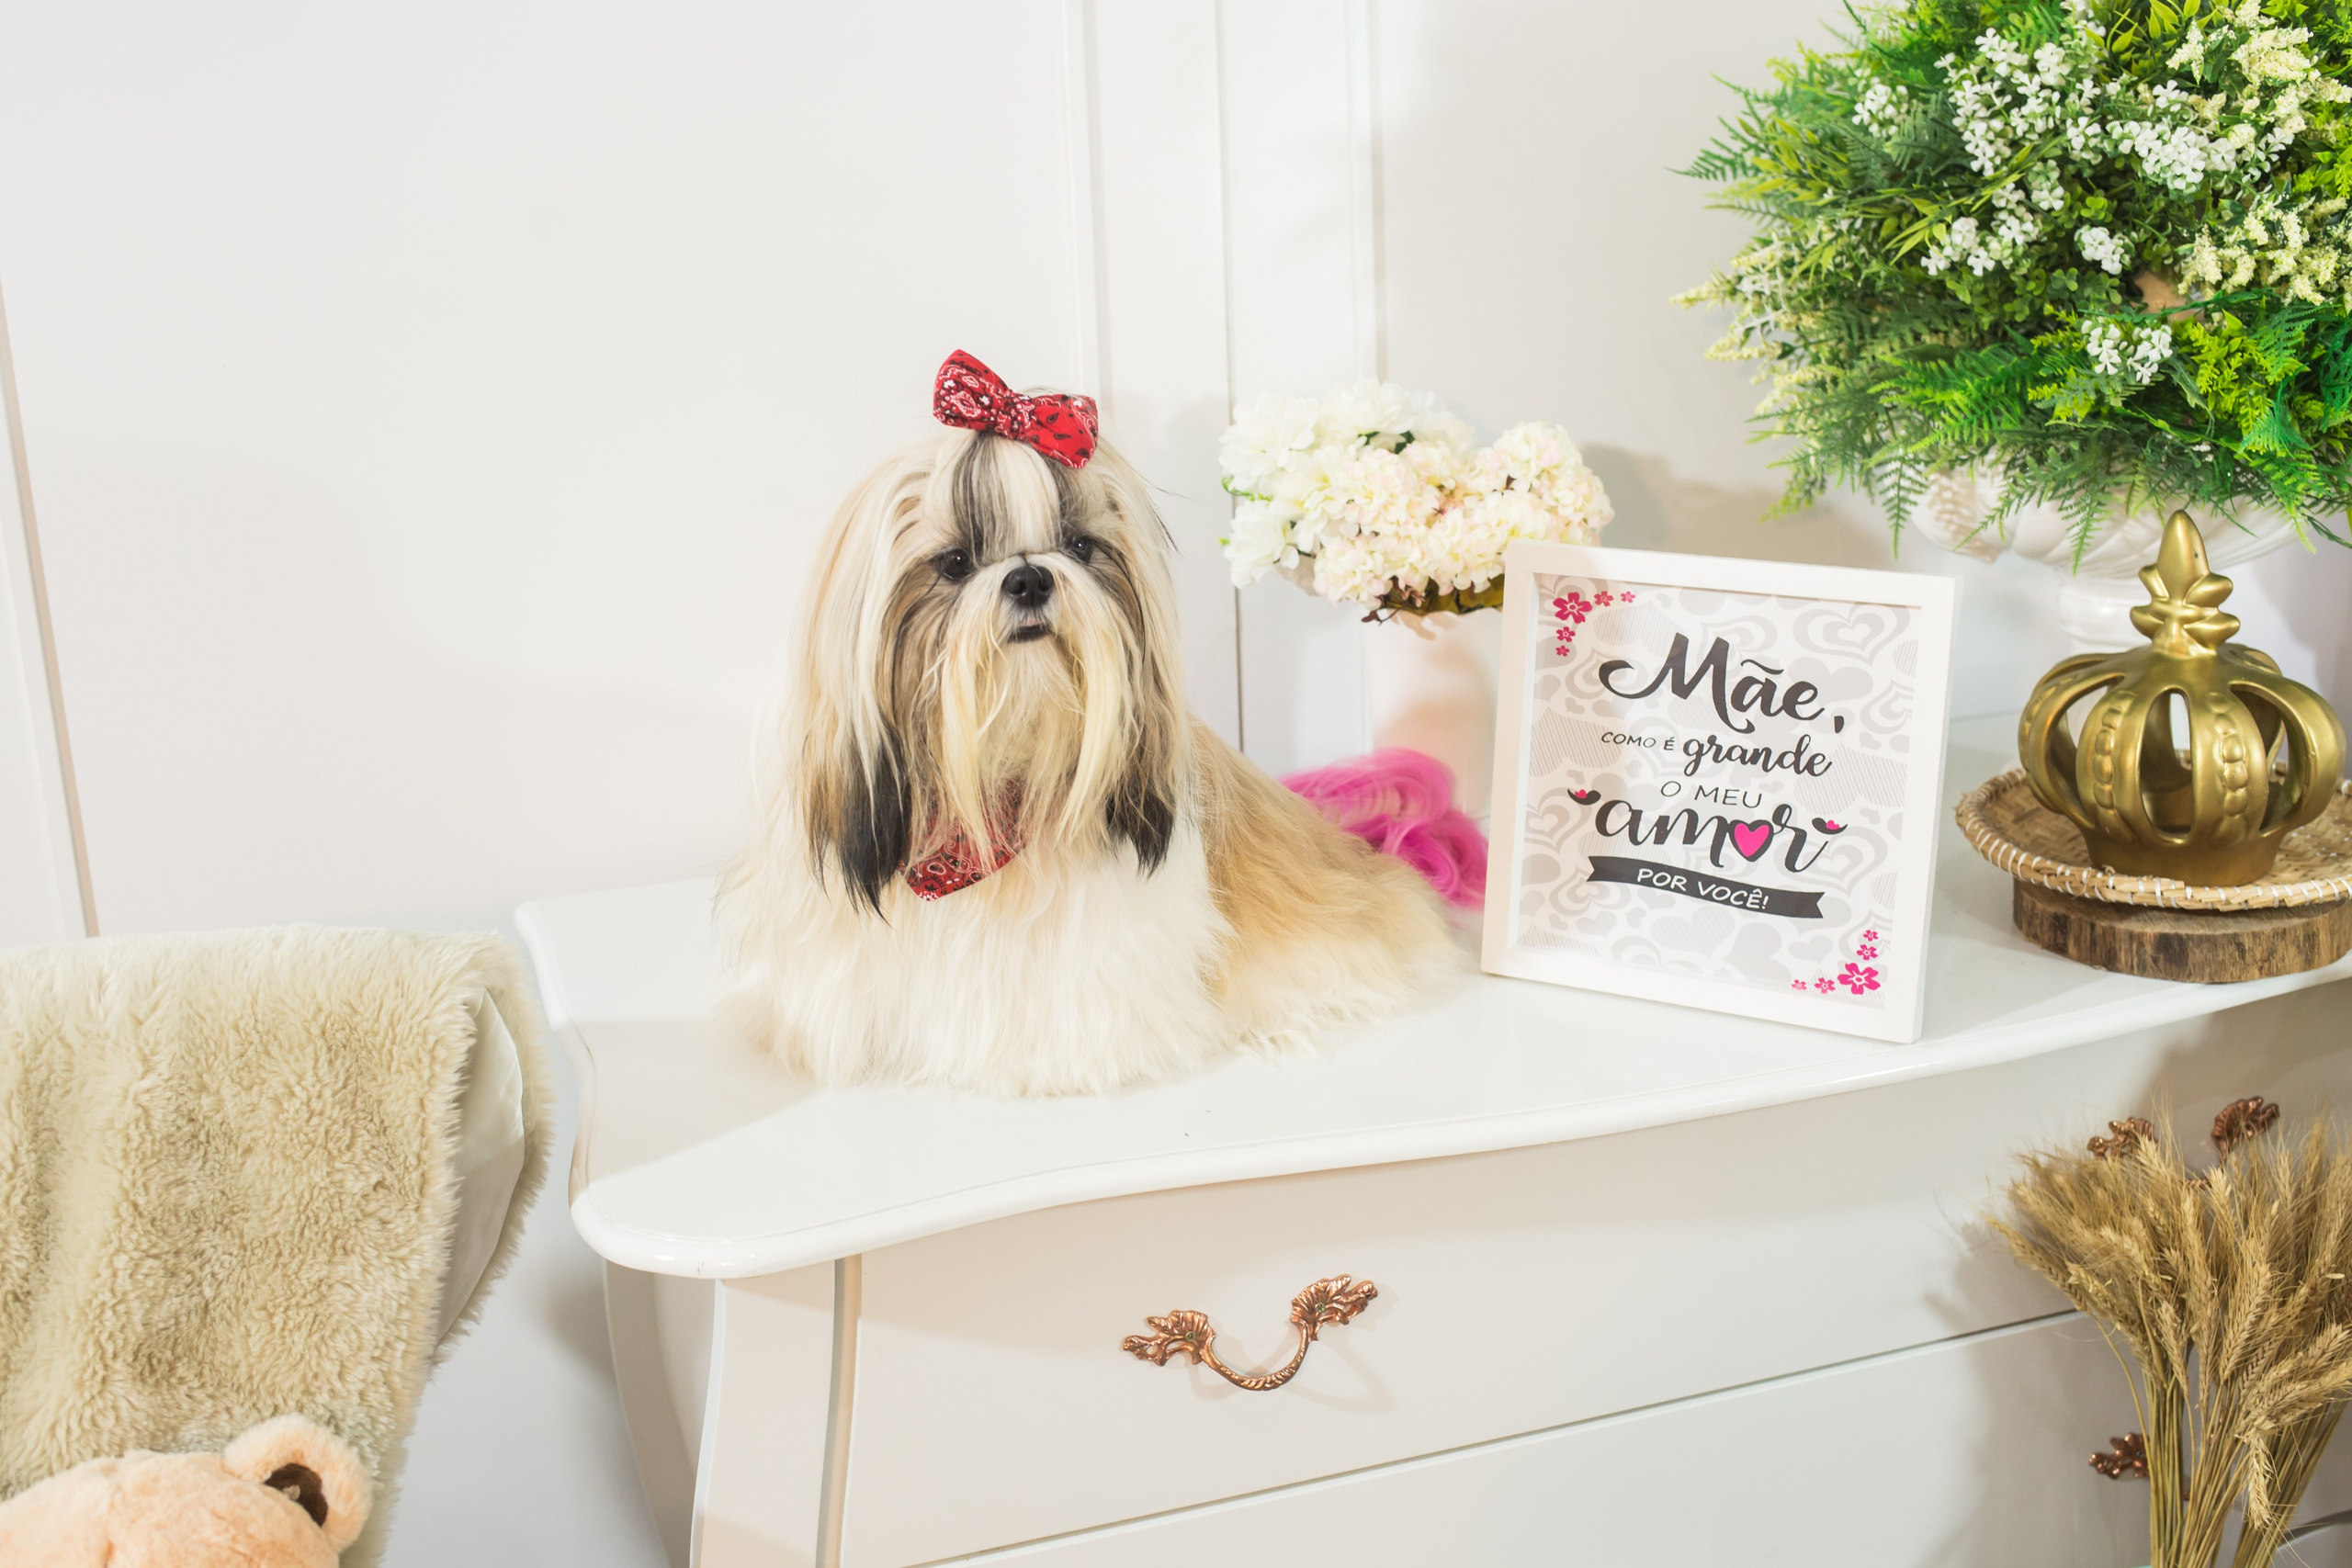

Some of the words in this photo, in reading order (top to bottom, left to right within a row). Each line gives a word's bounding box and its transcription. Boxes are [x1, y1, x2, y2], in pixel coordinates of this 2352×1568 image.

[1598, 632, 1845, 734] Mãe,
[1600, 731, 1657, 749] COMO
[1663, 736, 1676, 751] É
[1682, 734, 1832, 777] grande
[1660, 780, 1681, 797] O
[1693, 786, 1763, 808] MEU
[1595, 800, 1828, 873] amor
[1636, 867, 1688, 892] POR
[1698, 882, 1770, 910] VOCÊ!
